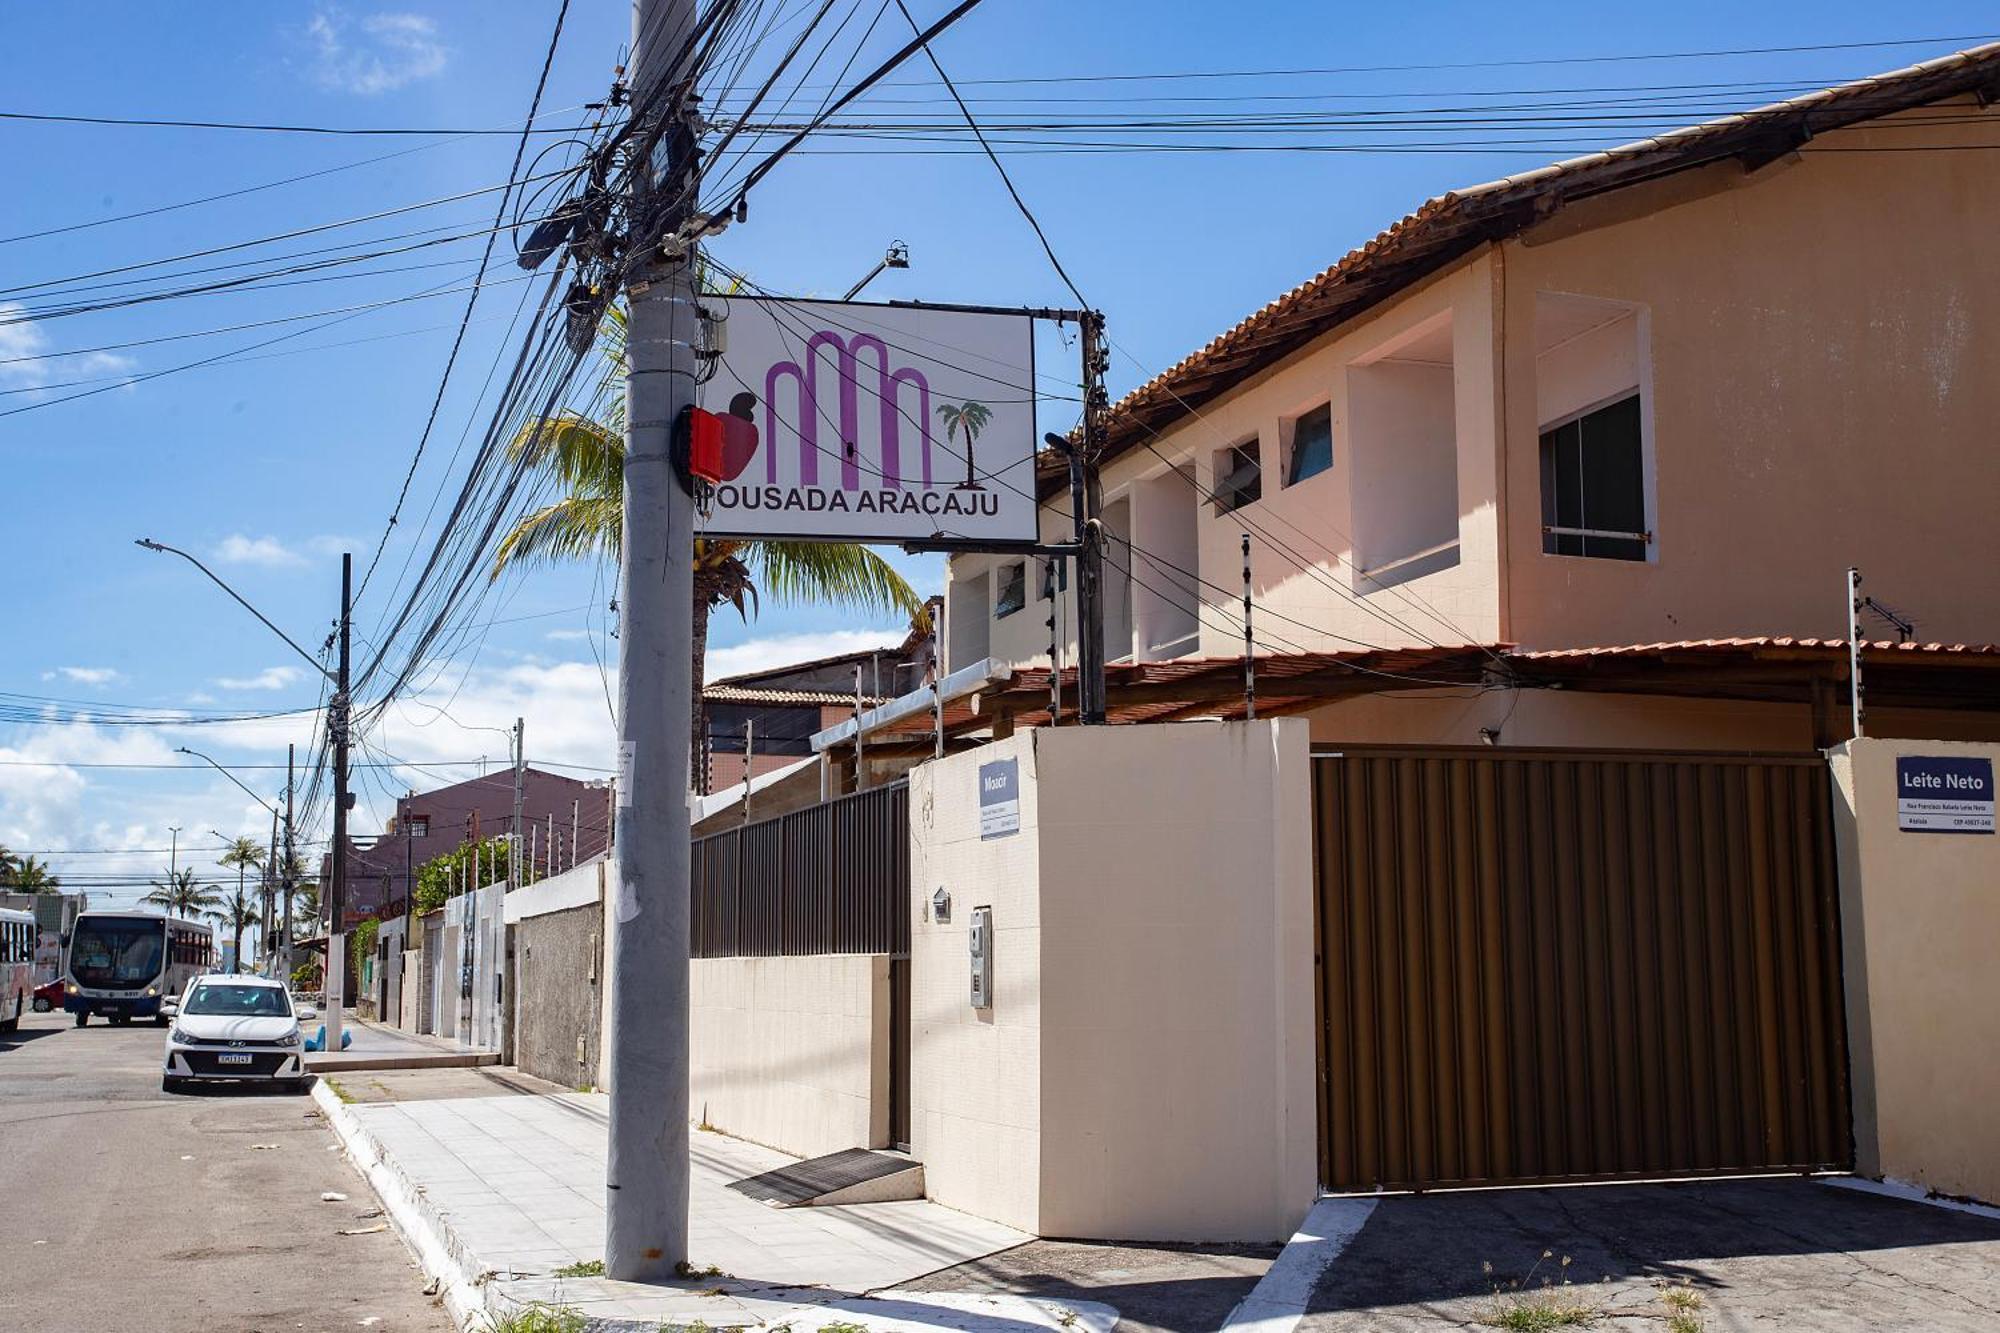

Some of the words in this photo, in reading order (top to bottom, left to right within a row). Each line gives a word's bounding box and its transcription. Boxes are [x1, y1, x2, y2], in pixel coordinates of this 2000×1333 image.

[704, 485, 850, 514] POUSADA
[856, 490, 999, 516] ARACAJU
[1904, 772, 1942, 788] Leite
[1946, 774, 1984, 790] Neto
